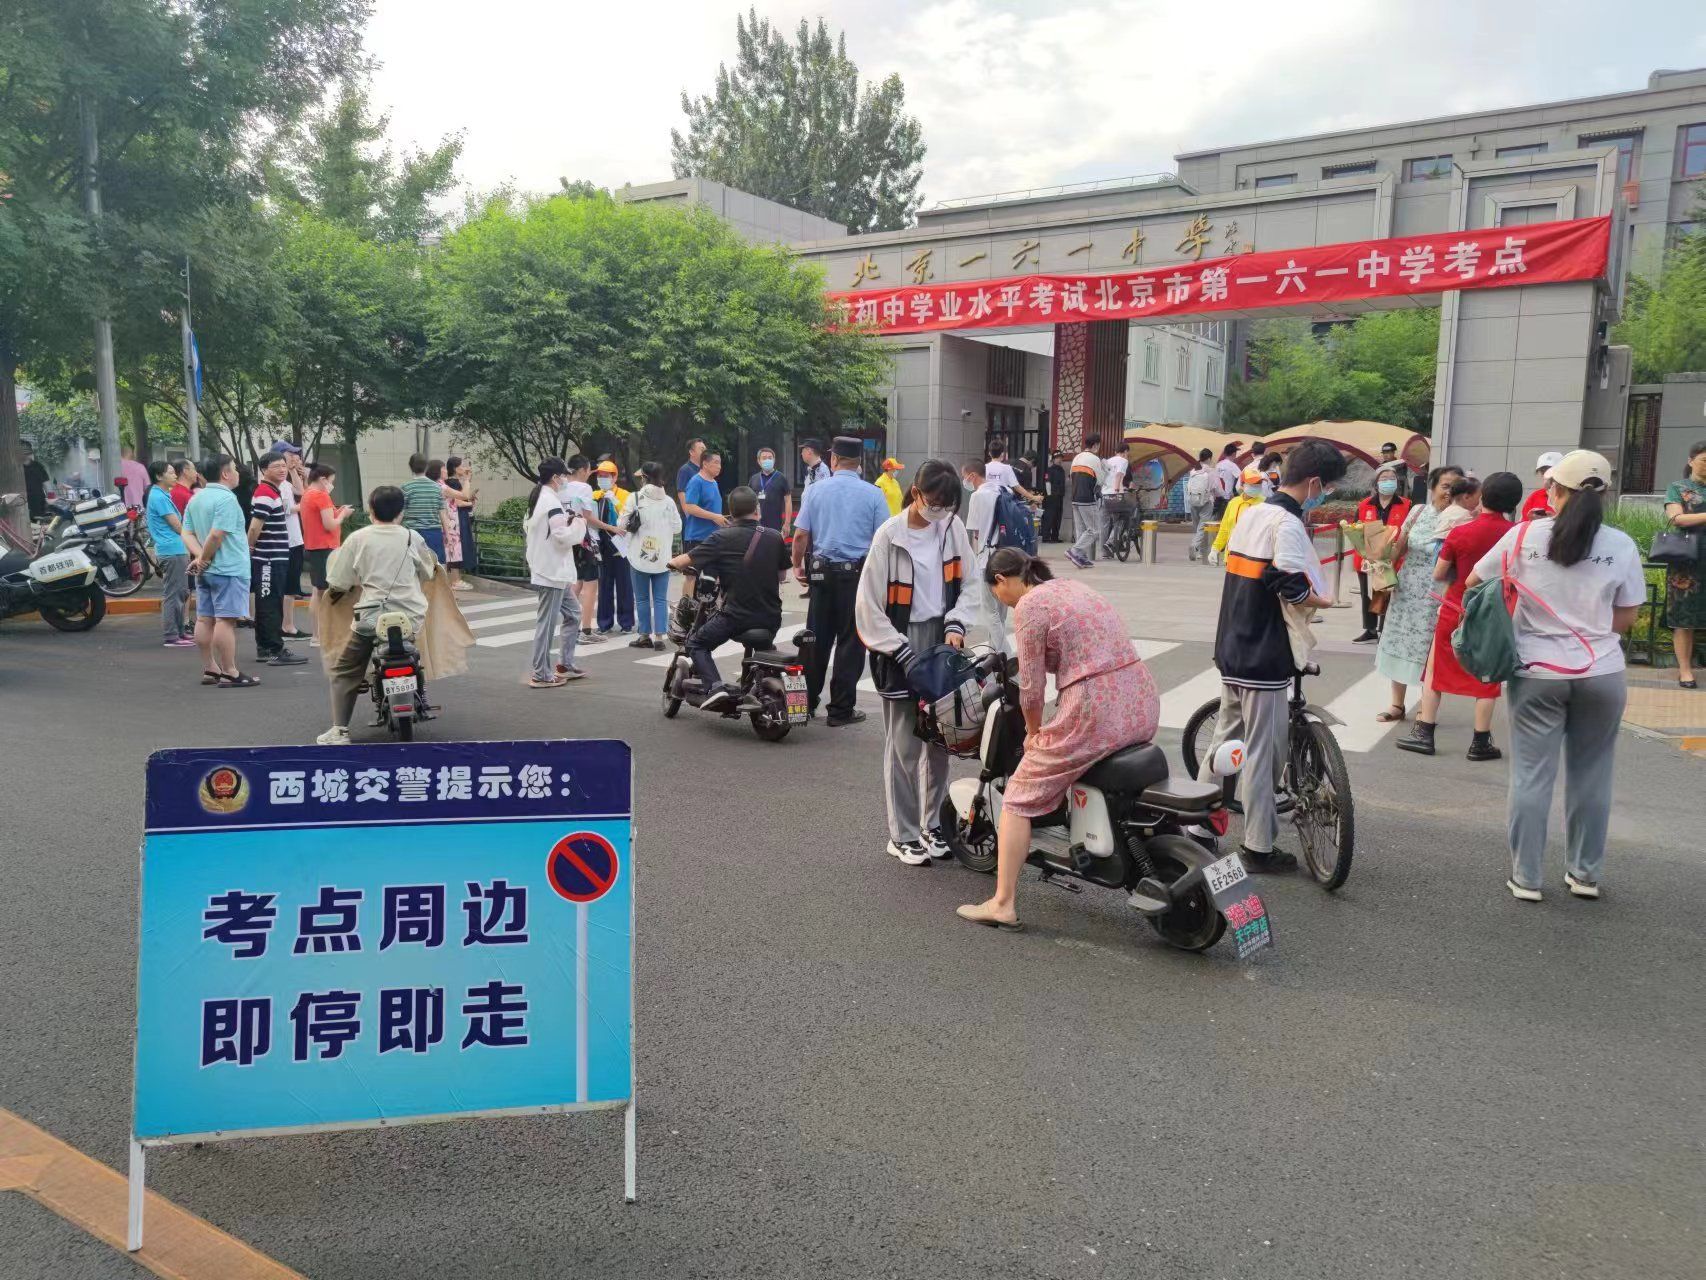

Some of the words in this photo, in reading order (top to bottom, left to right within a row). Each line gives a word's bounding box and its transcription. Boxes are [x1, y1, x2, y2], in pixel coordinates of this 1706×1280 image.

[1211, 866, 1245, 891] EF2568
[202, 879, 529, 960] 考点周边
[1224, 894, 1265, 930] 雅迪
[201, 980, 530, 1068] 即停即走
